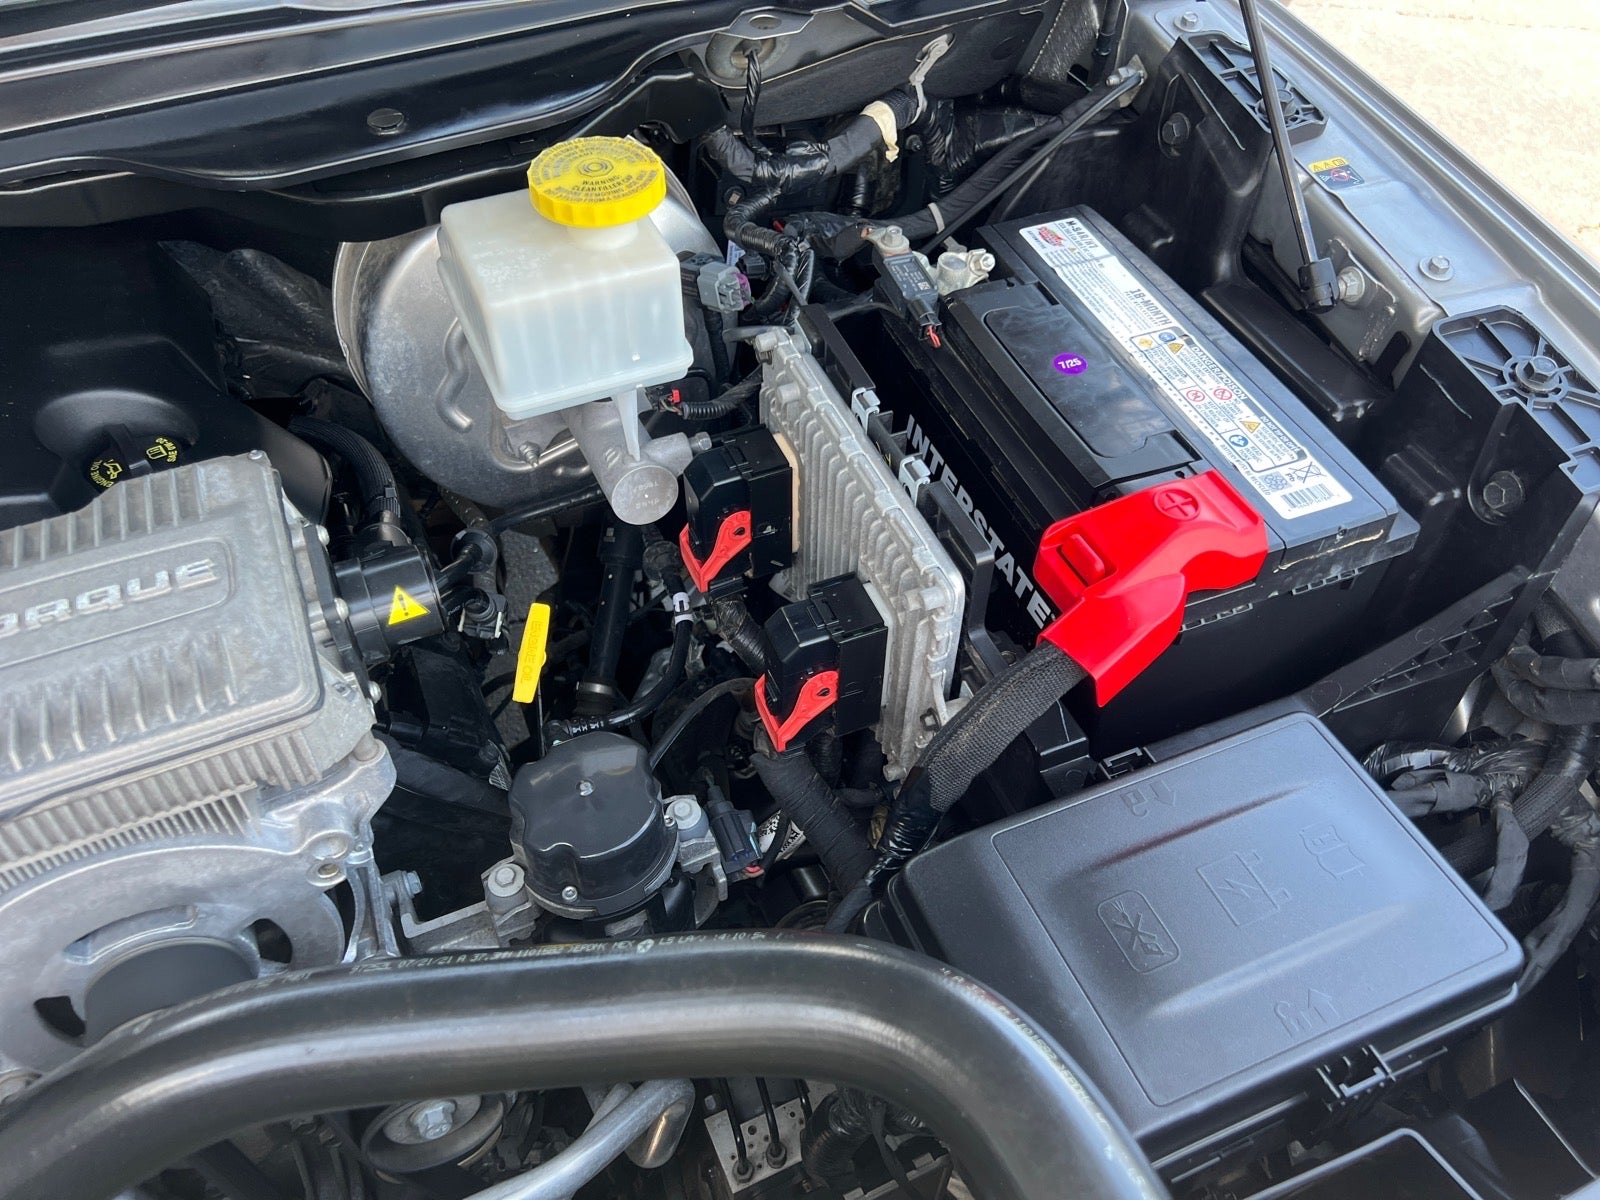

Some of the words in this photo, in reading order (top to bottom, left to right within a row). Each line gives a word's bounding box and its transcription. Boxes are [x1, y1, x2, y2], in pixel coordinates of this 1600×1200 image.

[1128, 288, 1173, 325] 18-MONTH
[1057, 357, 1082, 369] 7/25
[1189, 345, 1248, 400] DANGER/POISON
[1283, 472, 1297, 482] Pb
[906, 414, 1051, 630] INTERSTATE
[525, 620, 545, 664] ENGINE
[520, 665, 533, 684] OIL
[398, 956, 453, 969] 07/21/21
